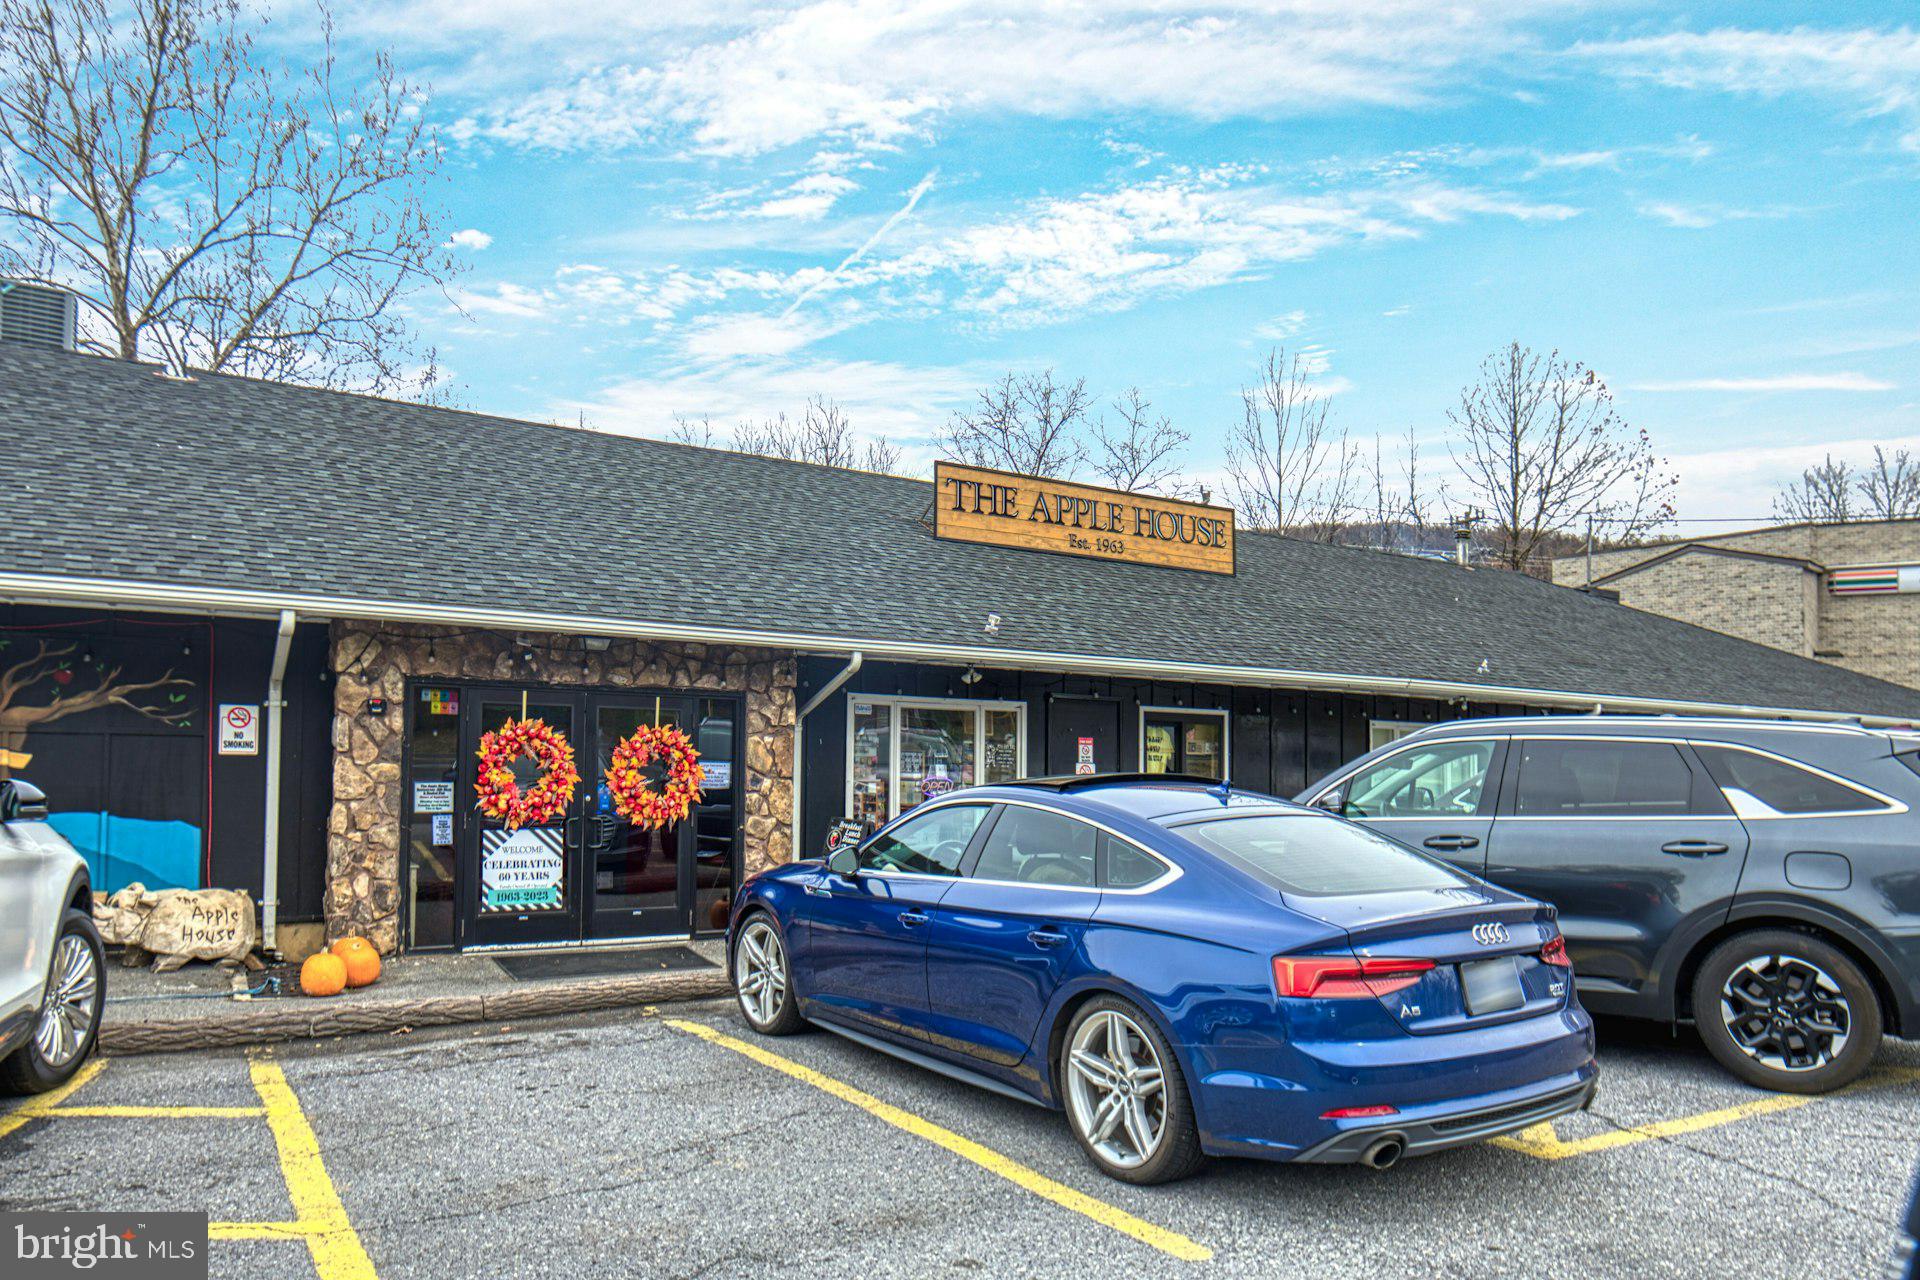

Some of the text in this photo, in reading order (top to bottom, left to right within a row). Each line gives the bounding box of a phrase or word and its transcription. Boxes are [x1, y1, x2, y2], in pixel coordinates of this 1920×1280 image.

[946, 477, 1227, 549] THE APPLE HOUSE
[1068, 533, 1125, 555] Est. 1963
[233, 730, 244, 739] NO
[223, 740, 254, 749] SMOKING
[921, 781, 954, 794] OPEN
[502, 845, 544, 854] WELCOME
[484, 859, 561, 870] CELEBRATING
[498, 871, 550, 881] 60 YEARS
[496, 890, 549, 902] 1963-2023
[192, 906, 238, 925] Apple
[183, 925, 235, 943] House
[1400, 1004, 1421, 1019] A5
